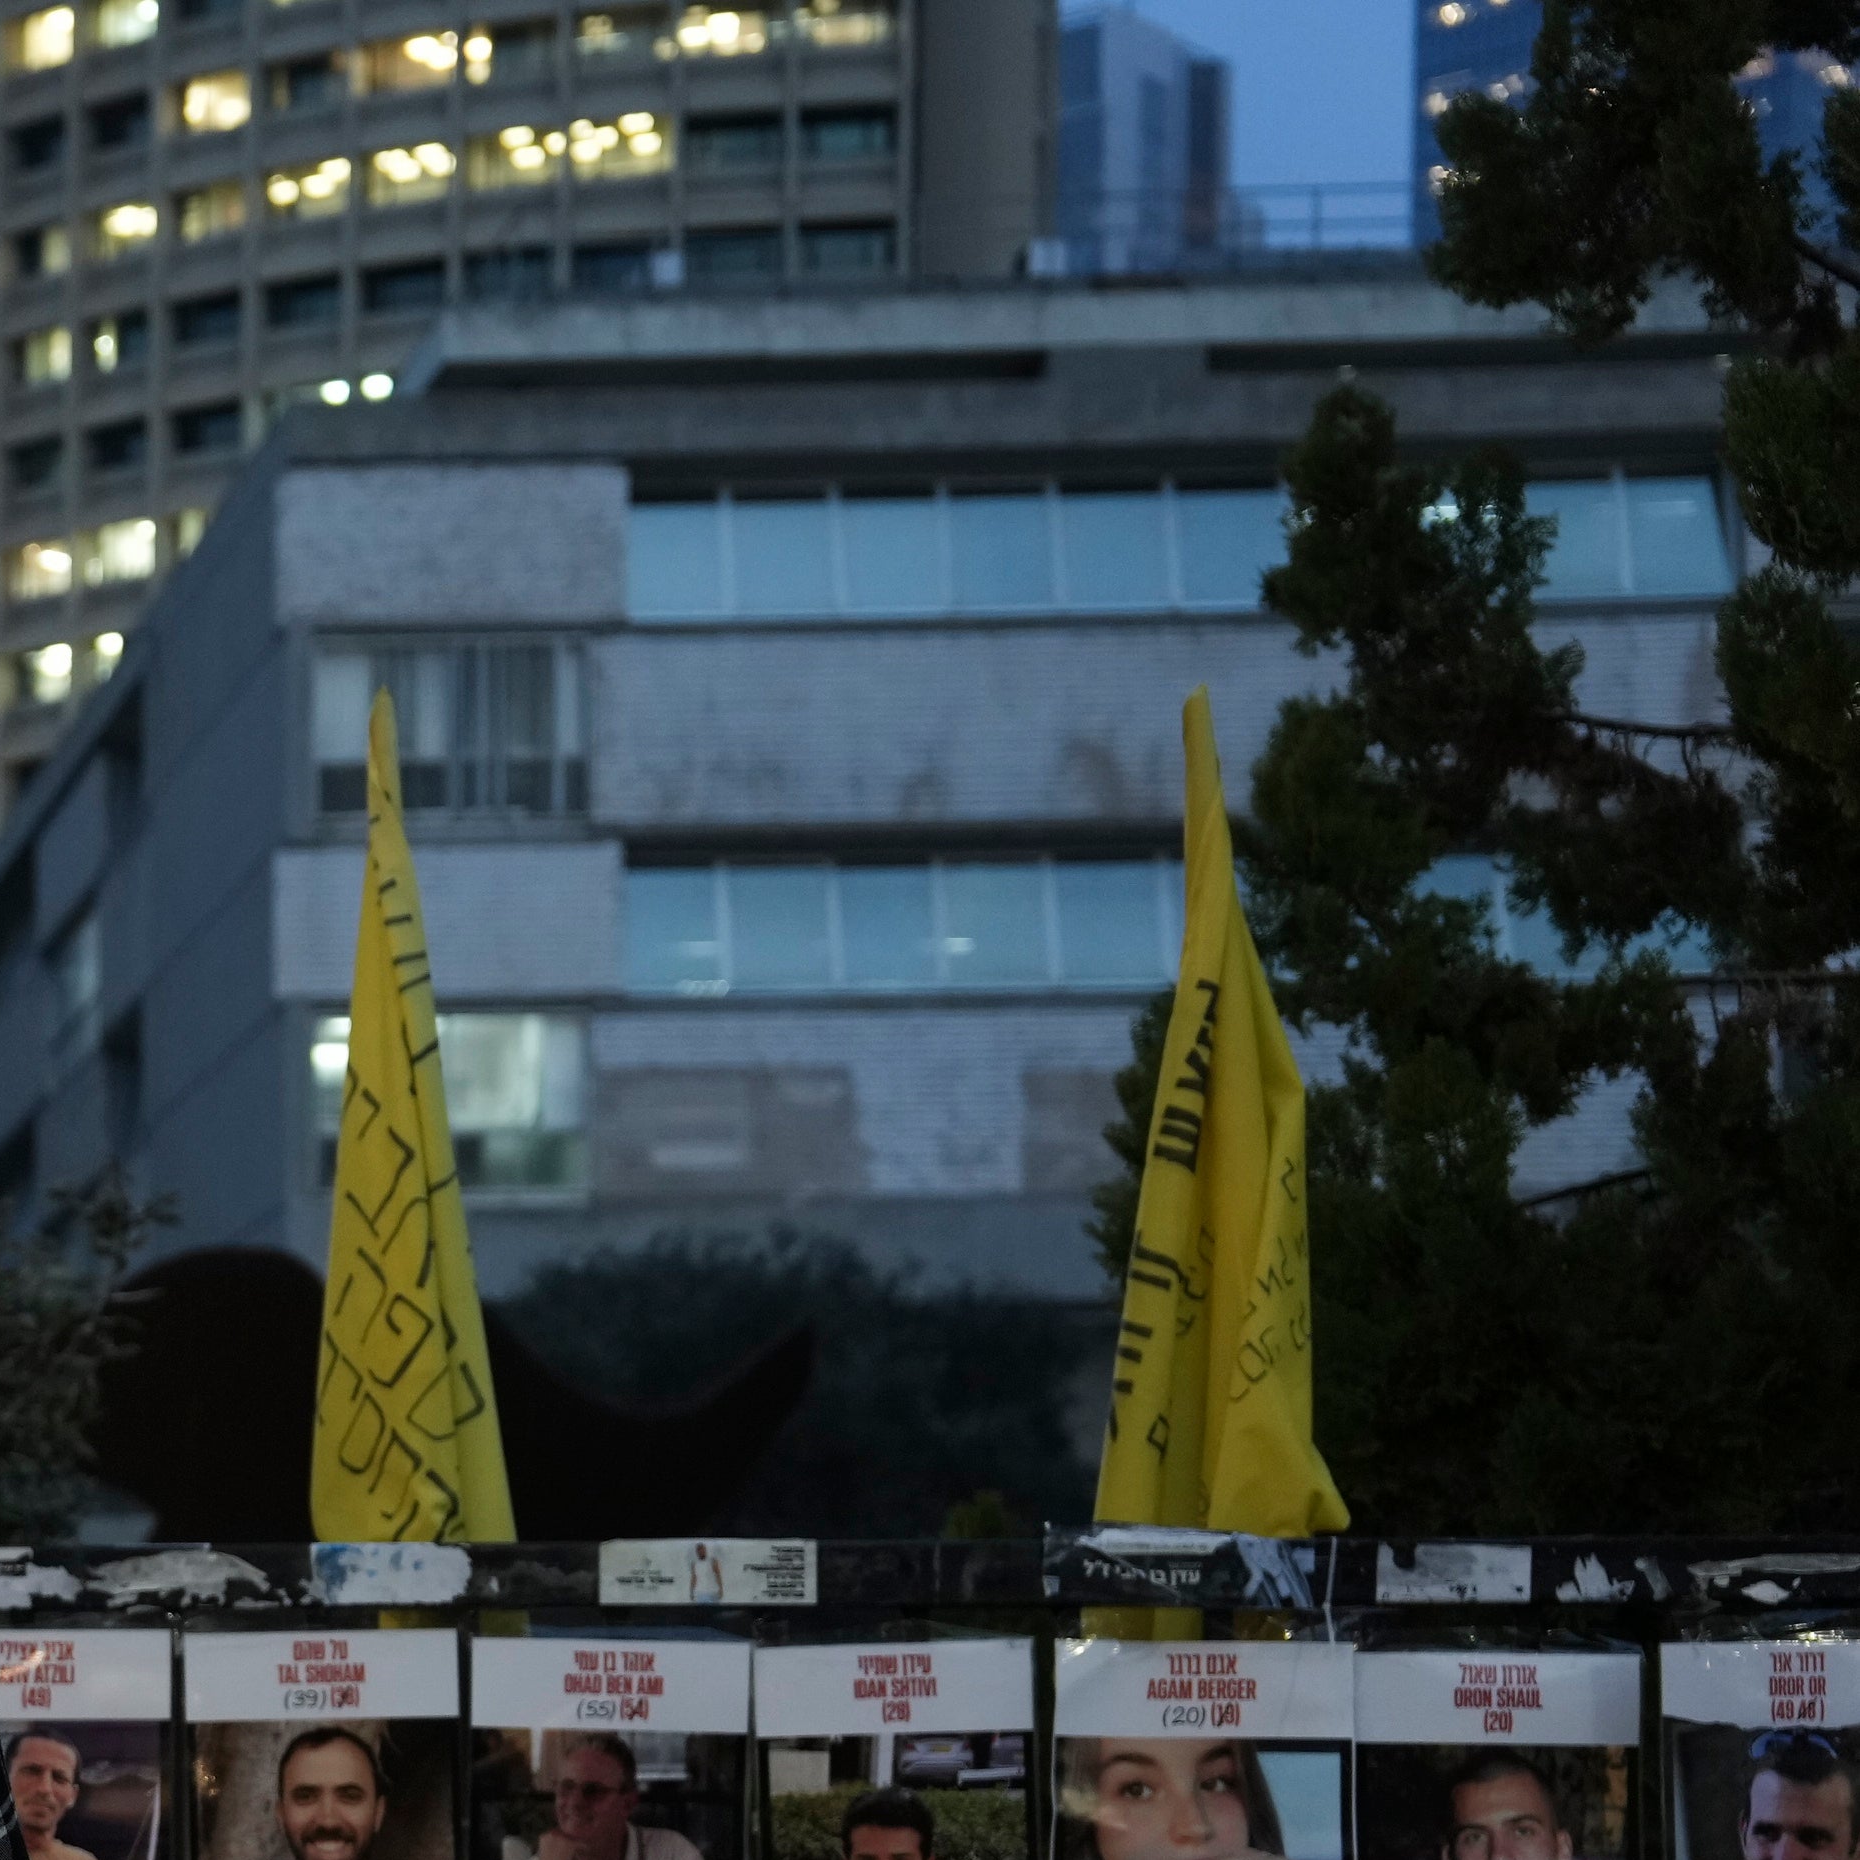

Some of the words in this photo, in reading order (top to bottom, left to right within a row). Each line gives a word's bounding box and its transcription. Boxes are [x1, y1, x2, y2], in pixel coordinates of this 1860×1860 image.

[293, 1641, 327, 1660] שוהם
[332, 1640, 347, 1660] טל
[1168, 1654, 1201, 1674] ברגר
[1208, 1654, 1236, 1675] אגם
[1770, 1652, 1792, 1672] אור
[1798, 1652, 1825, 1672] דרור
[34, 1663, 74, 1684] ATZILI
[278, 1665, 301, 1684] TAL
[305, 1664, 365, 1684] SHOHAM
[1460, 1662, 1498, 1683] שאול
[1502, 1664, 1537, 1683] אורון
[564, 1674, 602, 1695] OHAD
[607, 1674, 632, 1695] BEN
[637, 1676, 663, 1696] AMI
[854, 1677, 886, 1698] IDAN
[892, 1677, 937, 1698] SHTIVI
[1147, 1679, 1192, 1699] AGAM
[1198, 1679, 1256, 1699] BERGER
[1770, 1677, 1804, 1695] DROR
[1809, 1677, 1826, 1695] OR
[22, 1686, 50, 1709] (49)
[1454, 1689, 1492, 1708] ORON
[1497, 1688, 1542, 1708] SHAUL
[1162, 1704, 1205, 1726] (20)
[1484, 1711, 1513, 1733] (20)
